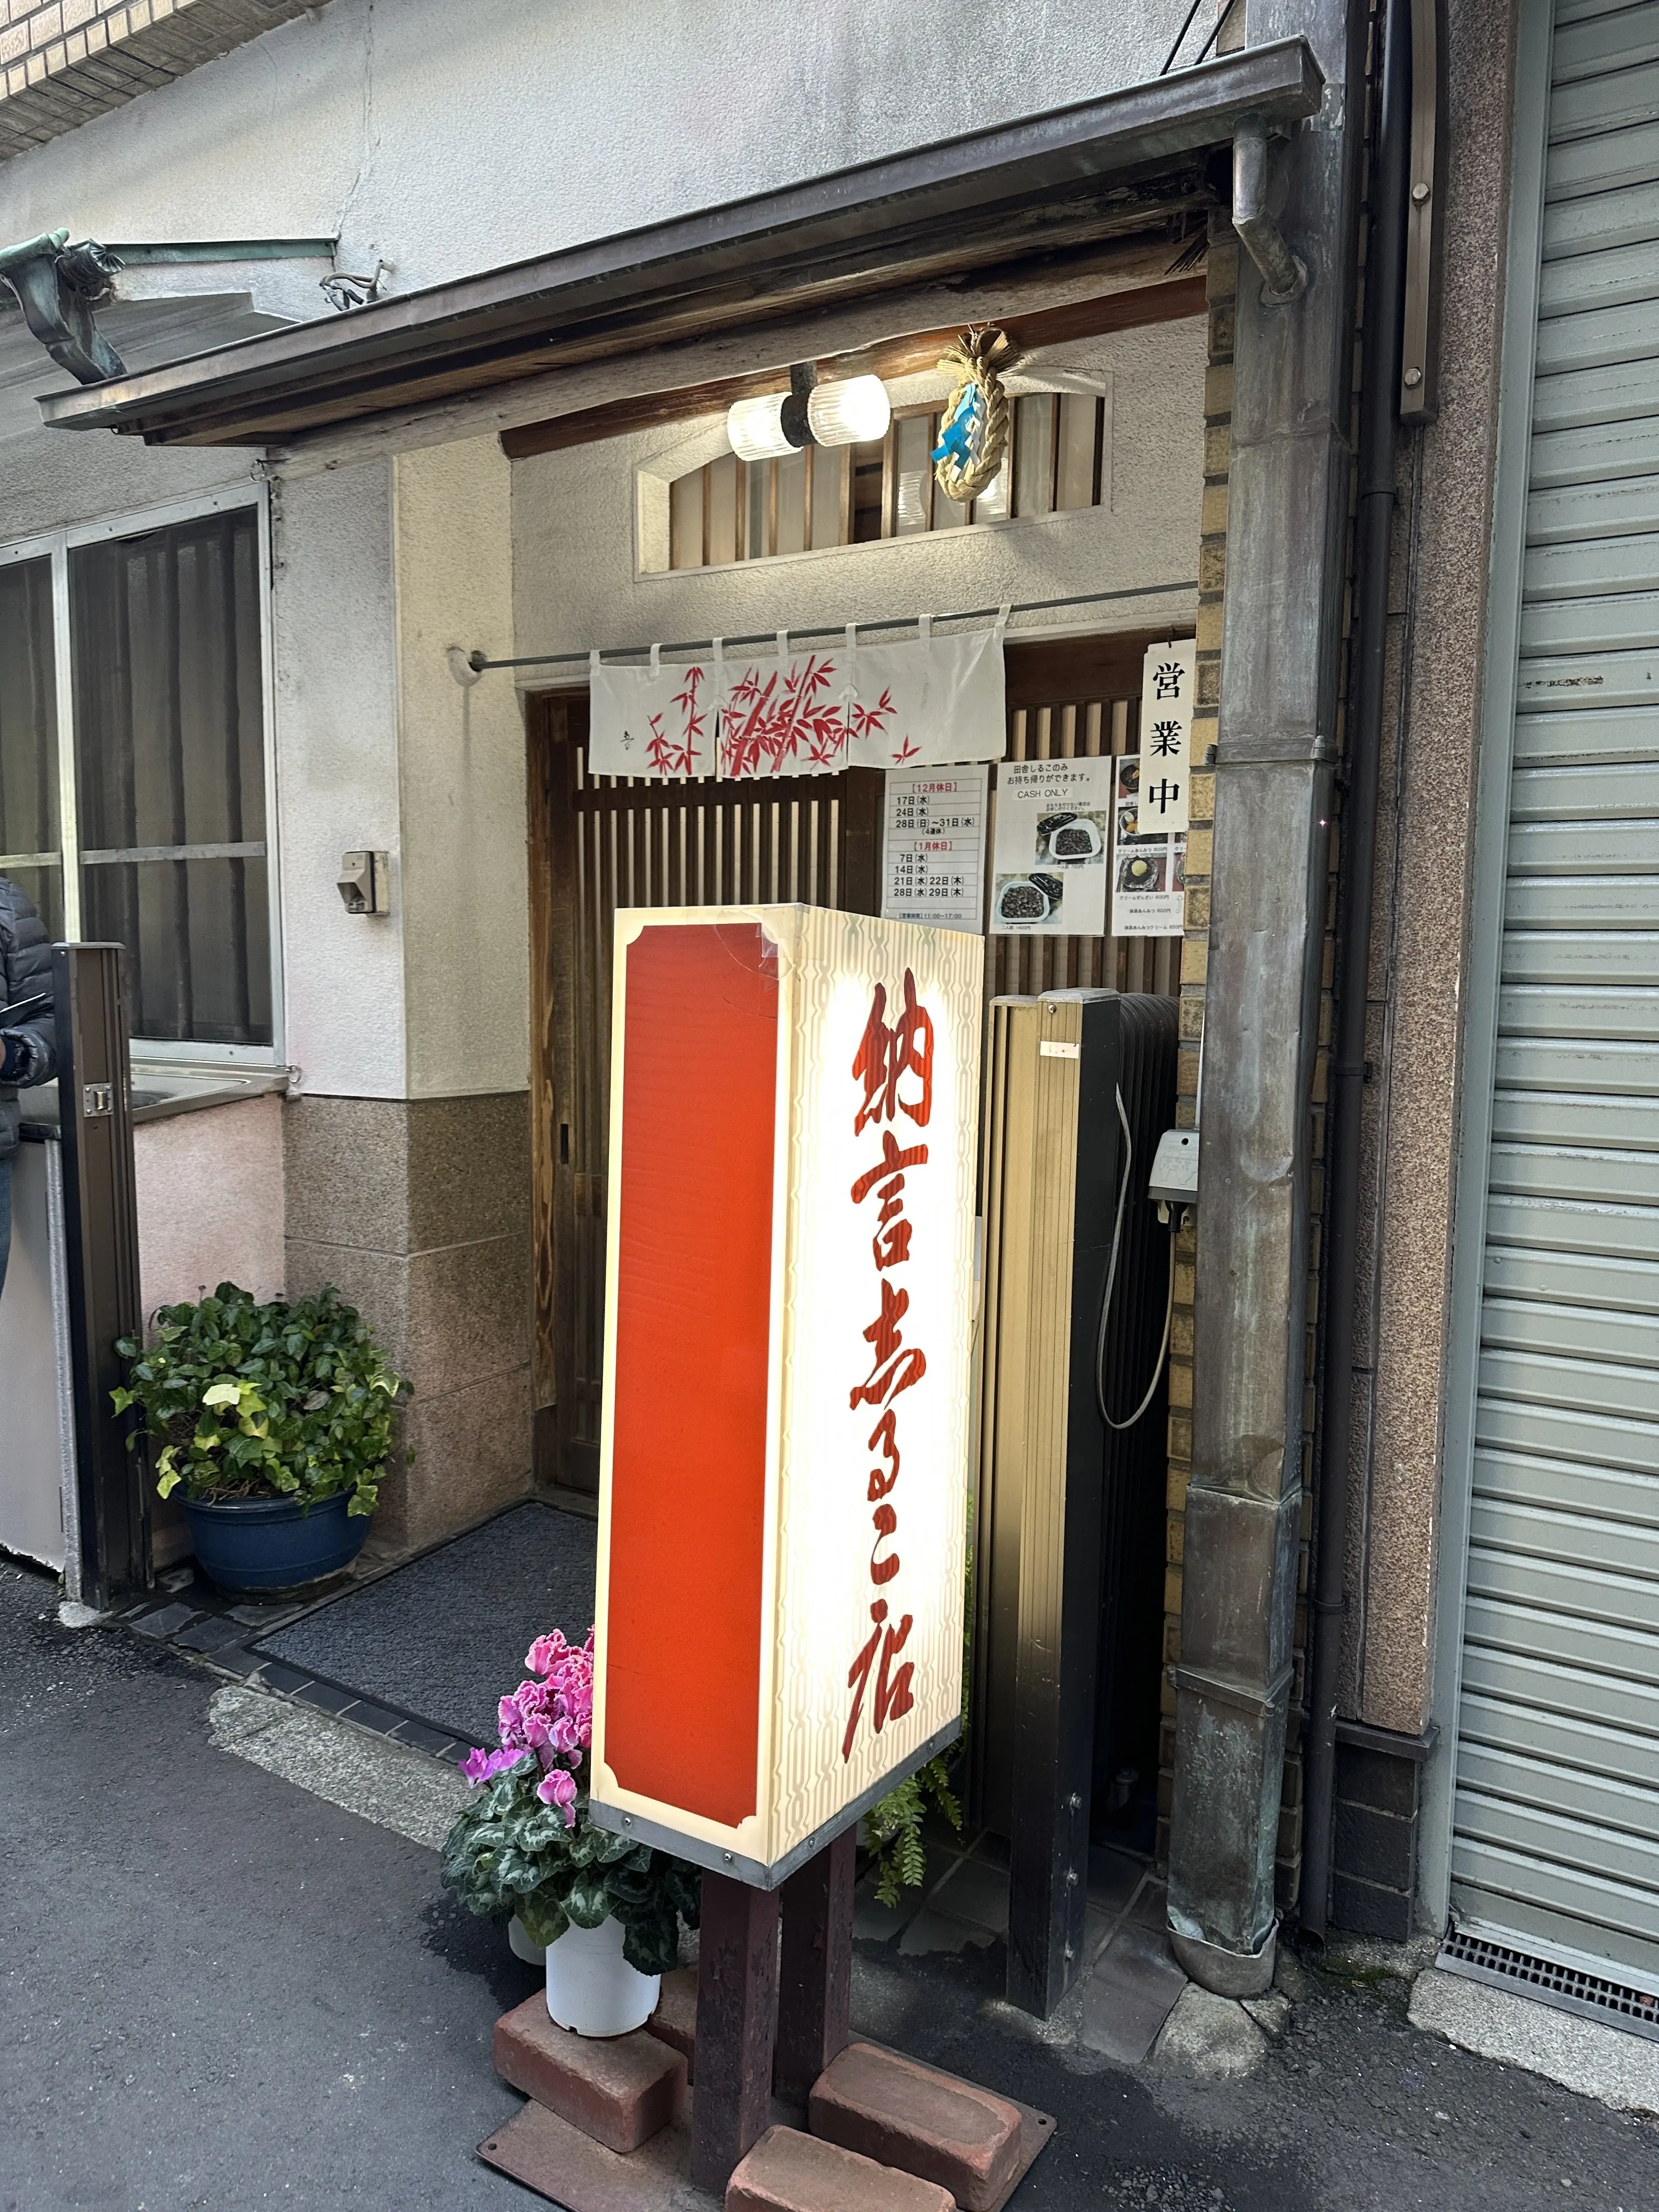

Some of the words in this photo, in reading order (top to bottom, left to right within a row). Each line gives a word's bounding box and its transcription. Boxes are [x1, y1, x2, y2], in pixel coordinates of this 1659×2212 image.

[1149, 662, 1185, 814] 営業中
[1014, 764, 1068, 774] 田舎しるこのみ
[1007, 773, 1090, 785] お持ち帰りができます。
[1017, 790, 1041, 799] CASH
[1045, 788, 1068, 797] ONLY
[897, 795, 930, 805] 17日(水)
[896, 807, 929, 816] 24日(水)
[900, 854, 928, 862] 7日(水)
[895, 865, 928, 874] 14日(水)
